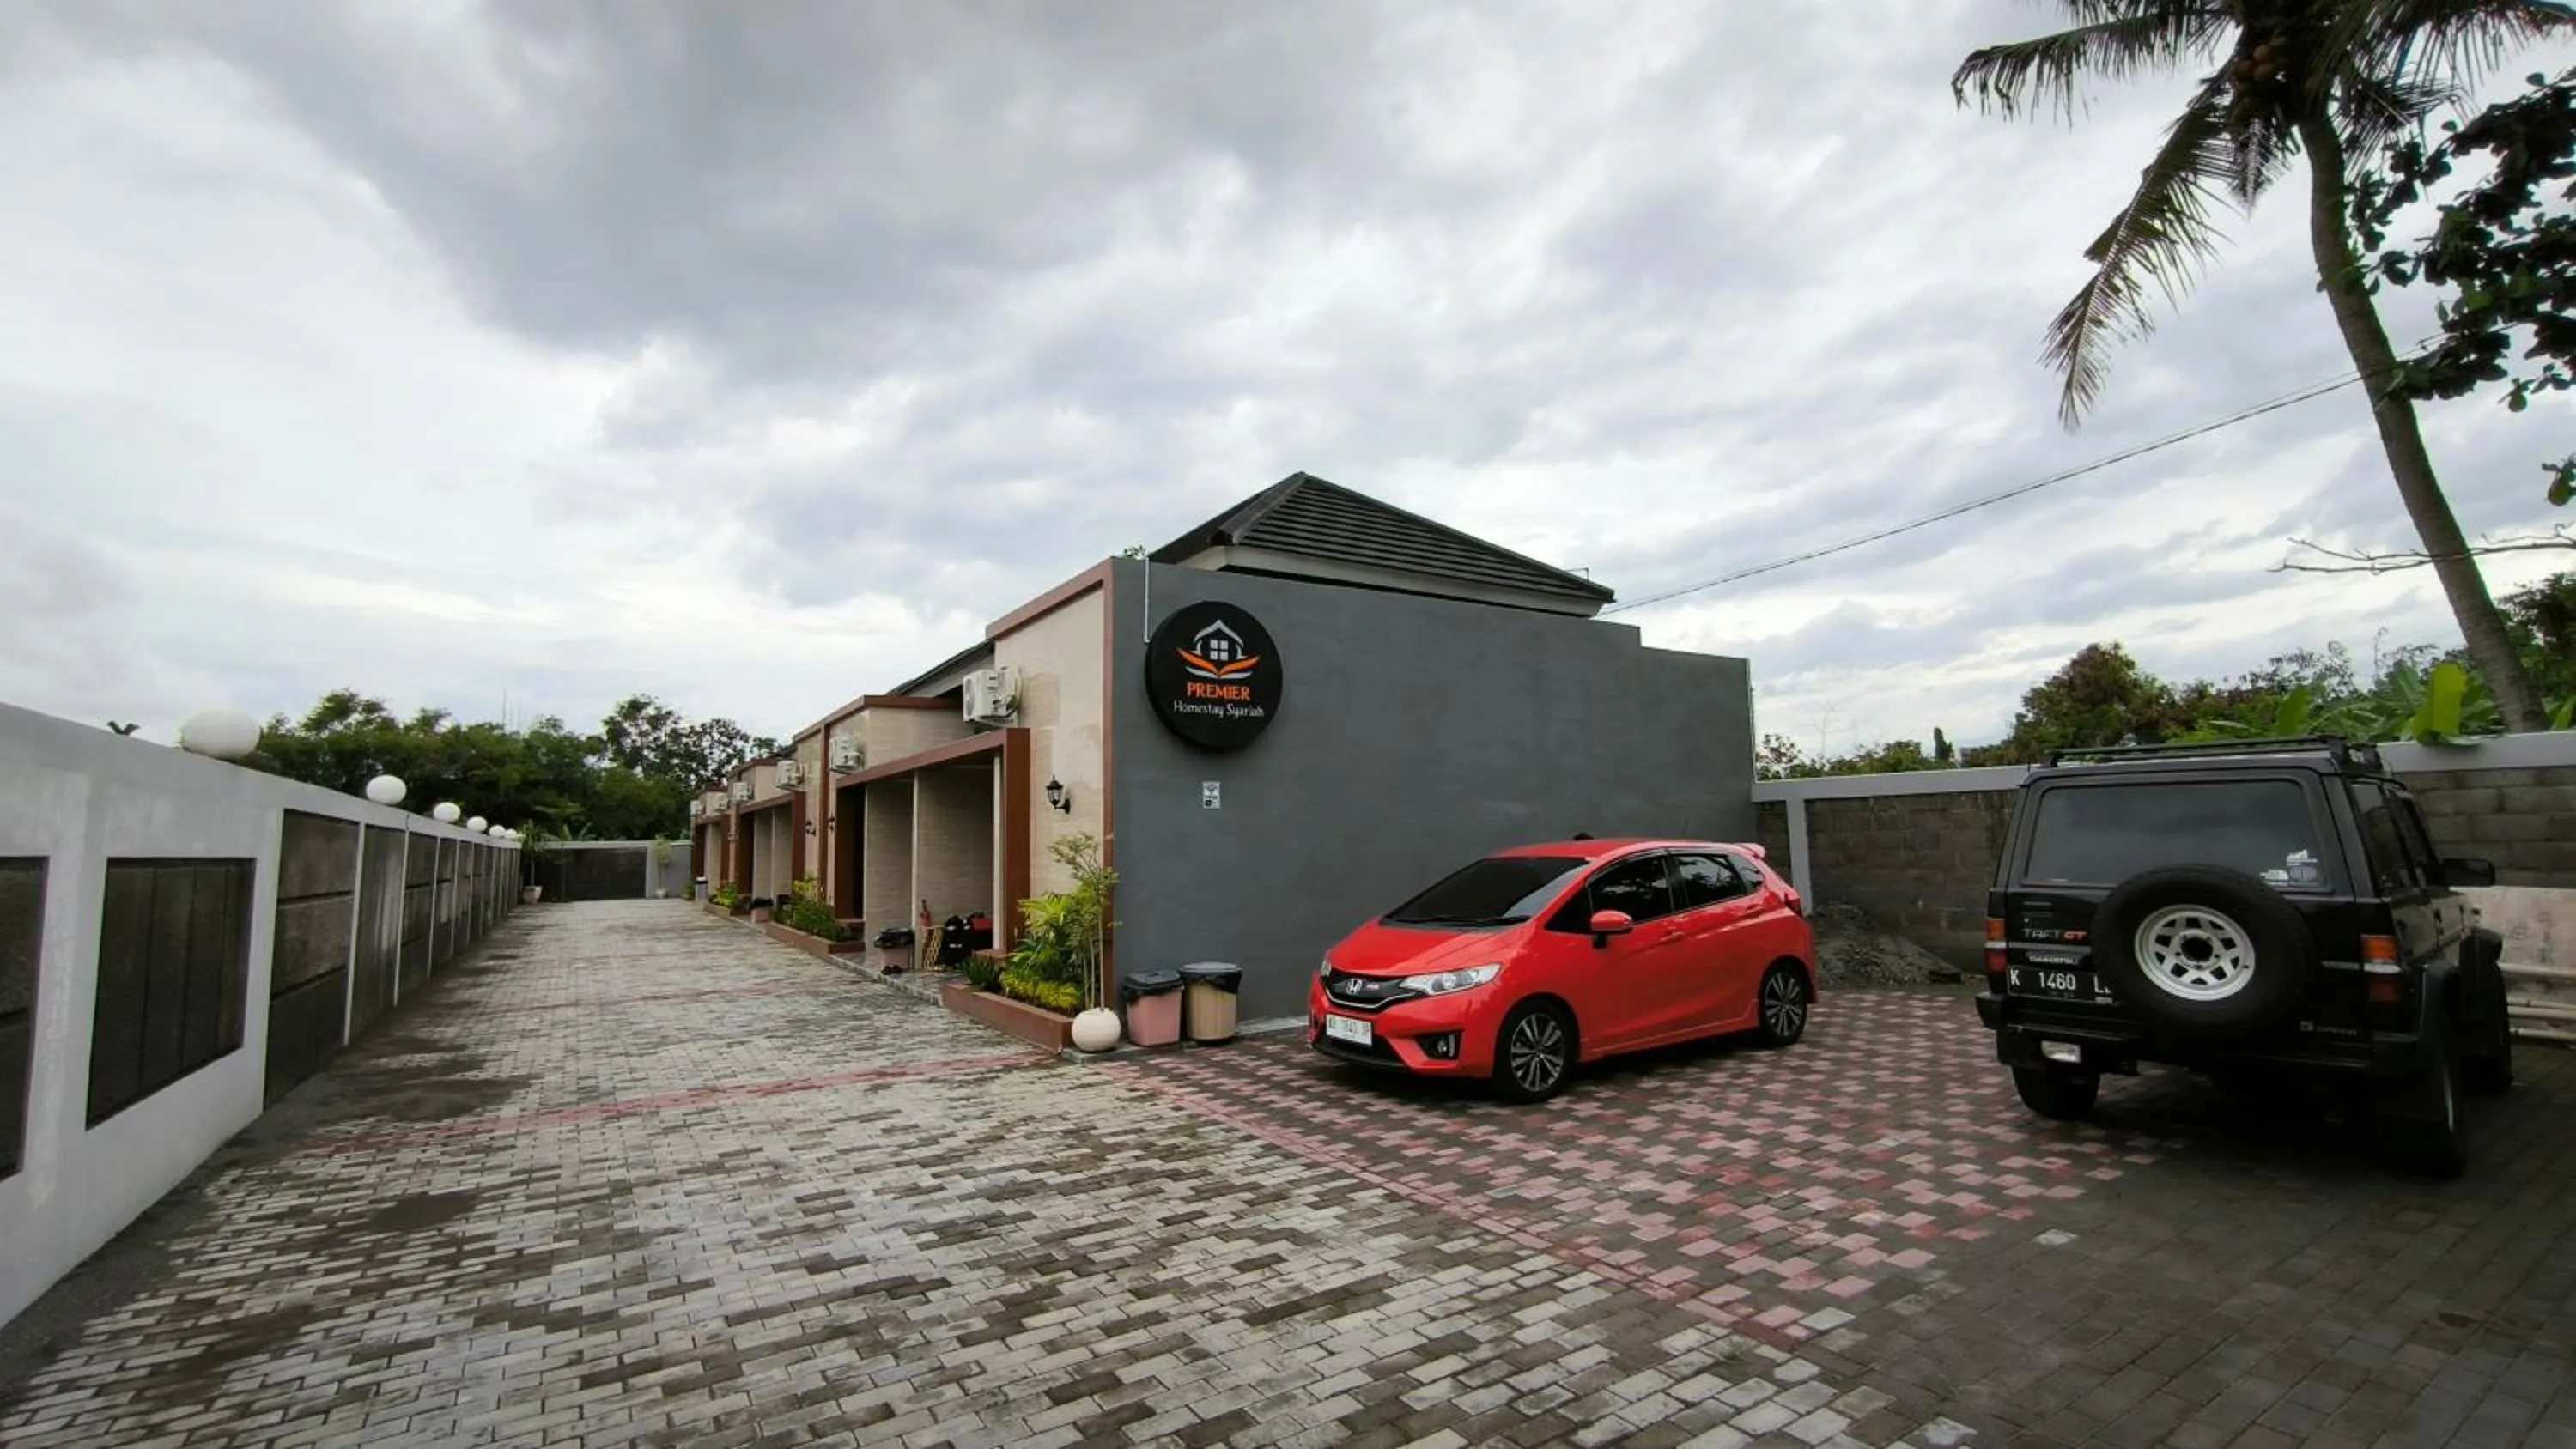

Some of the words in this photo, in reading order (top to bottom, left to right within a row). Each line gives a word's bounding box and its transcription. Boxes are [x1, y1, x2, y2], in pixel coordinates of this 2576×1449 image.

[1187, 682, 1251, 700] PREMIER
[1174, 700, 1224, 718] Homestay
[1226, 703, 1265, 719] Syariah
[2023, 928, 2061, 938] TAFT
[2063, 930, 2088, 940] GT
[2009, 968, 2020, 986] K
[2038, 971, 2076, 990] 1460
